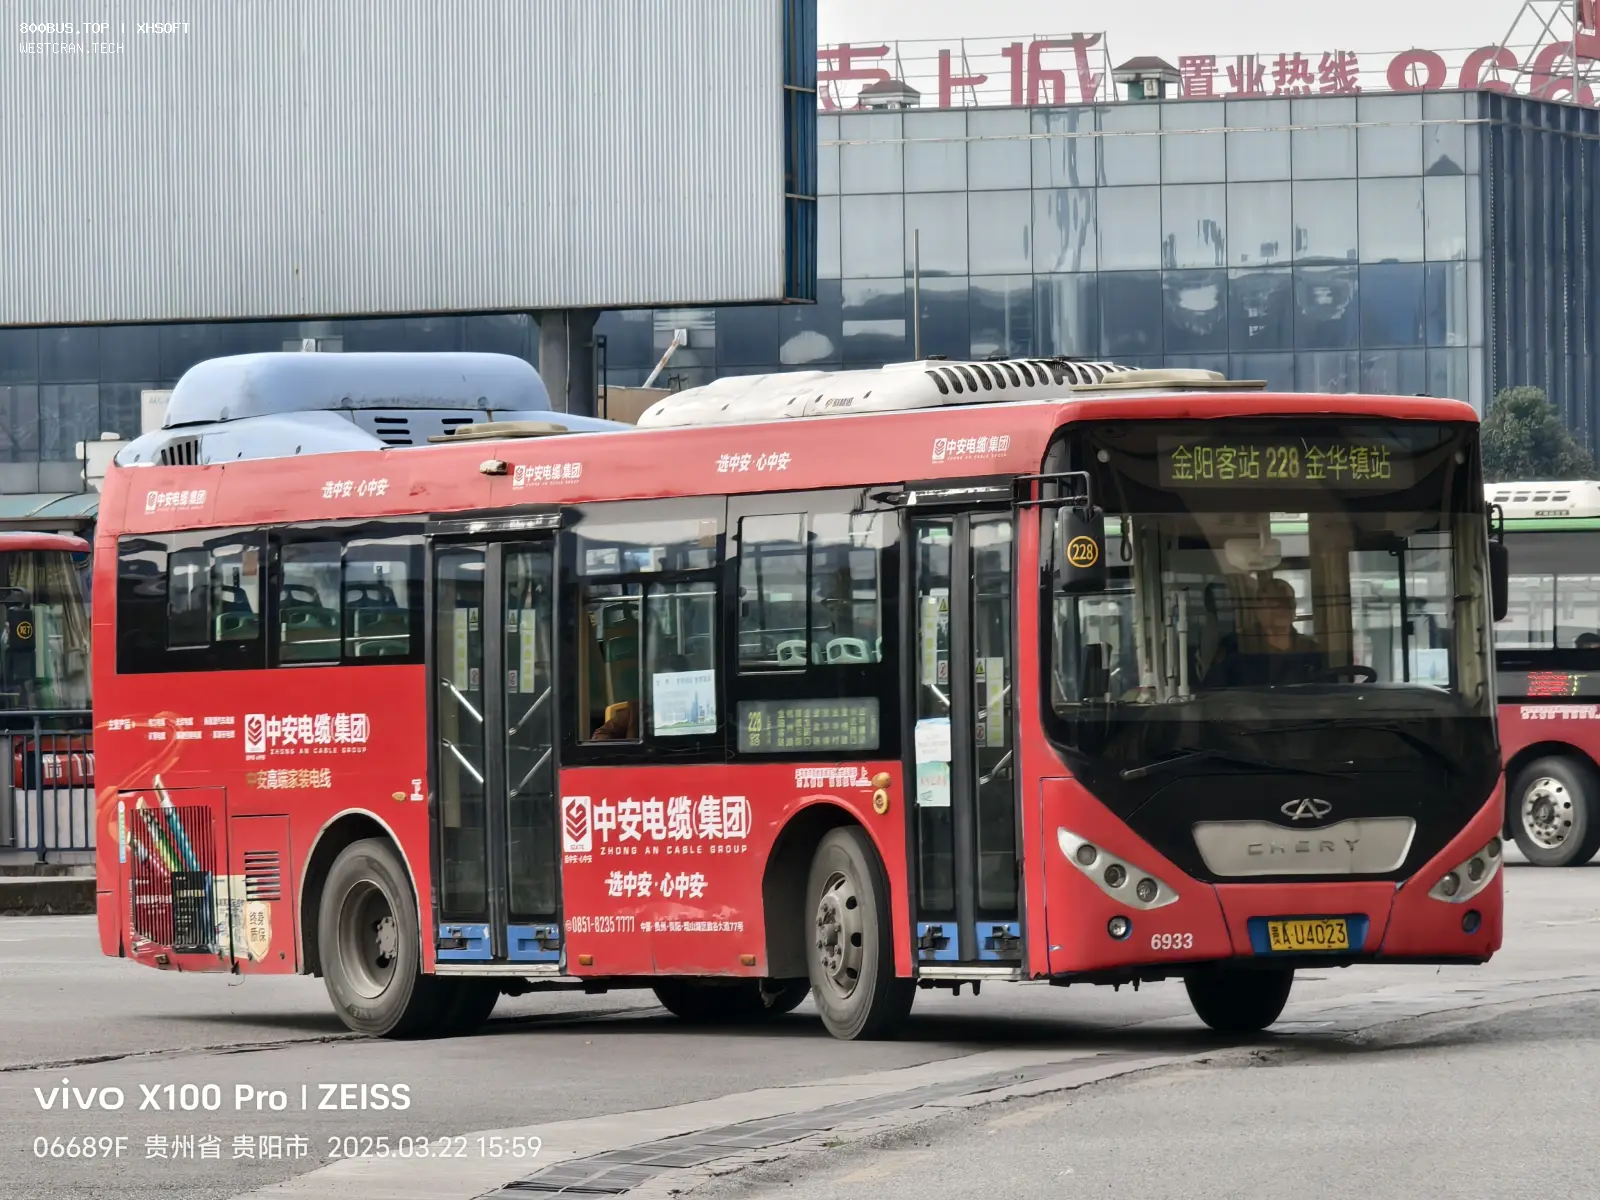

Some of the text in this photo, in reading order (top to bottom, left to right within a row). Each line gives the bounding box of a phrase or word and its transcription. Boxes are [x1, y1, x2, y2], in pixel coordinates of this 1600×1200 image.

[1178, 50, 1360, 99] 置业热线
[1171, 444, 1391, 481] 金阳客站 228 金华镇站
[1072, 544, 1094, 561] 228
[593, 795, 752, 843] 中安电缆(集团)
[600, 844, 747, 856] ZHONG AN CABLE GROUP
[1247, 838, 1360, 856] CHERY
[1150, 932, 1194, 950] 6933
